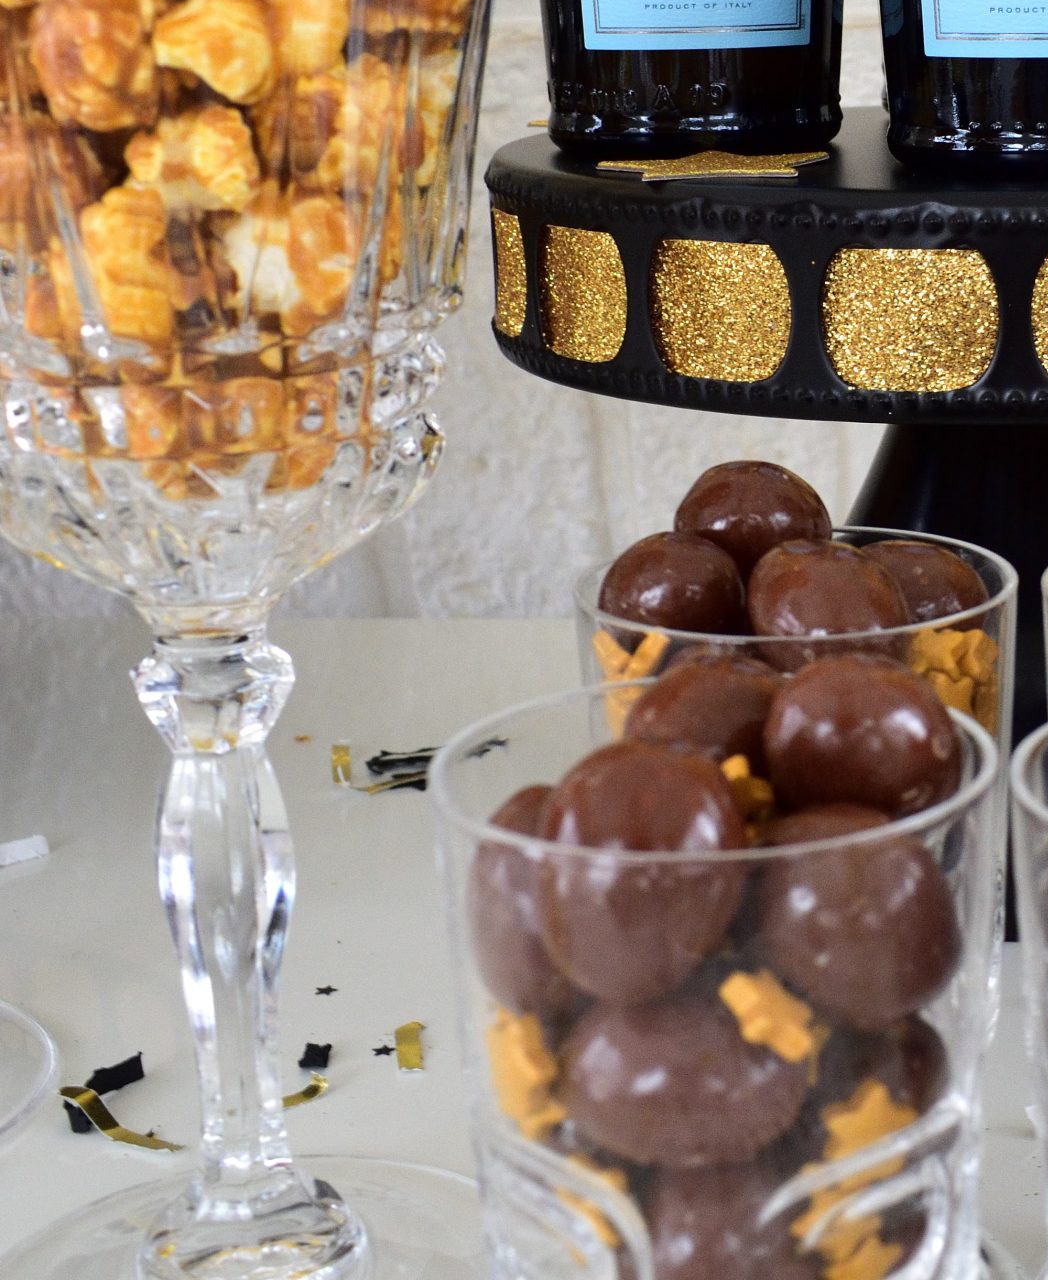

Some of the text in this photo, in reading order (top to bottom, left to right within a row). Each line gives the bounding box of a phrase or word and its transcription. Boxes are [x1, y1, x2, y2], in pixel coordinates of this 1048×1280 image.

[644, 2, 697, 10] PRODUCT
[725, 1, 753, 9] ITALY
[989, 6, 1046, 14] PRODUCT
